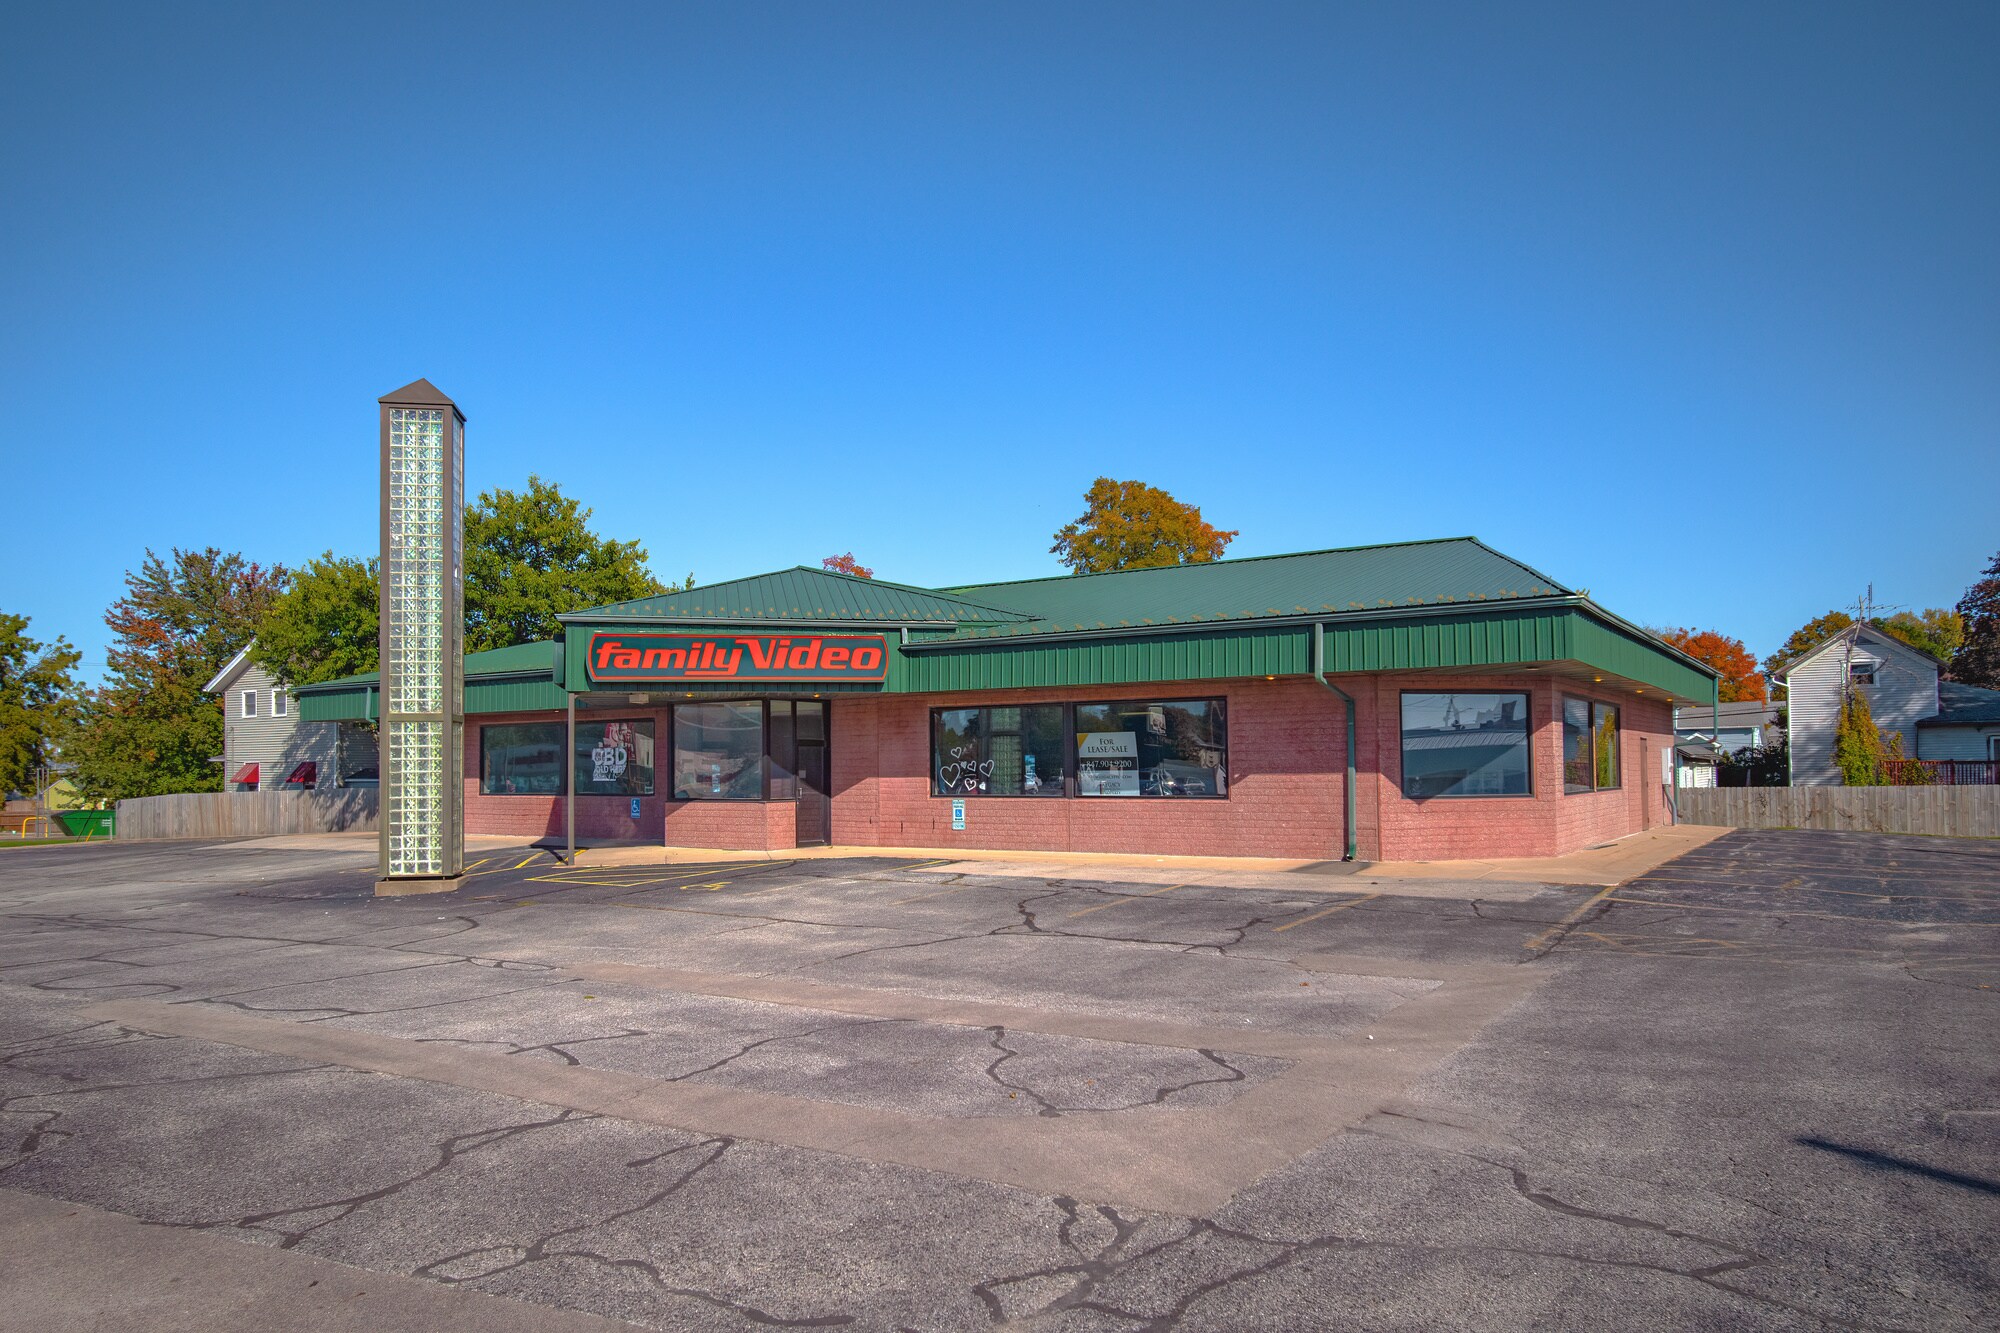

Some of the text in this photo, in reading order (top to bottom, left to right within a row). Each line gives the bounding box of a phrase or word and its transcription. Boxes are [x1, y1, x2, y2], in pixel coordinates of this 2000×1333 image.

[596, 638, 882, 676] family Video
[1088, 745, 1128, 753] LEASE/SALE
